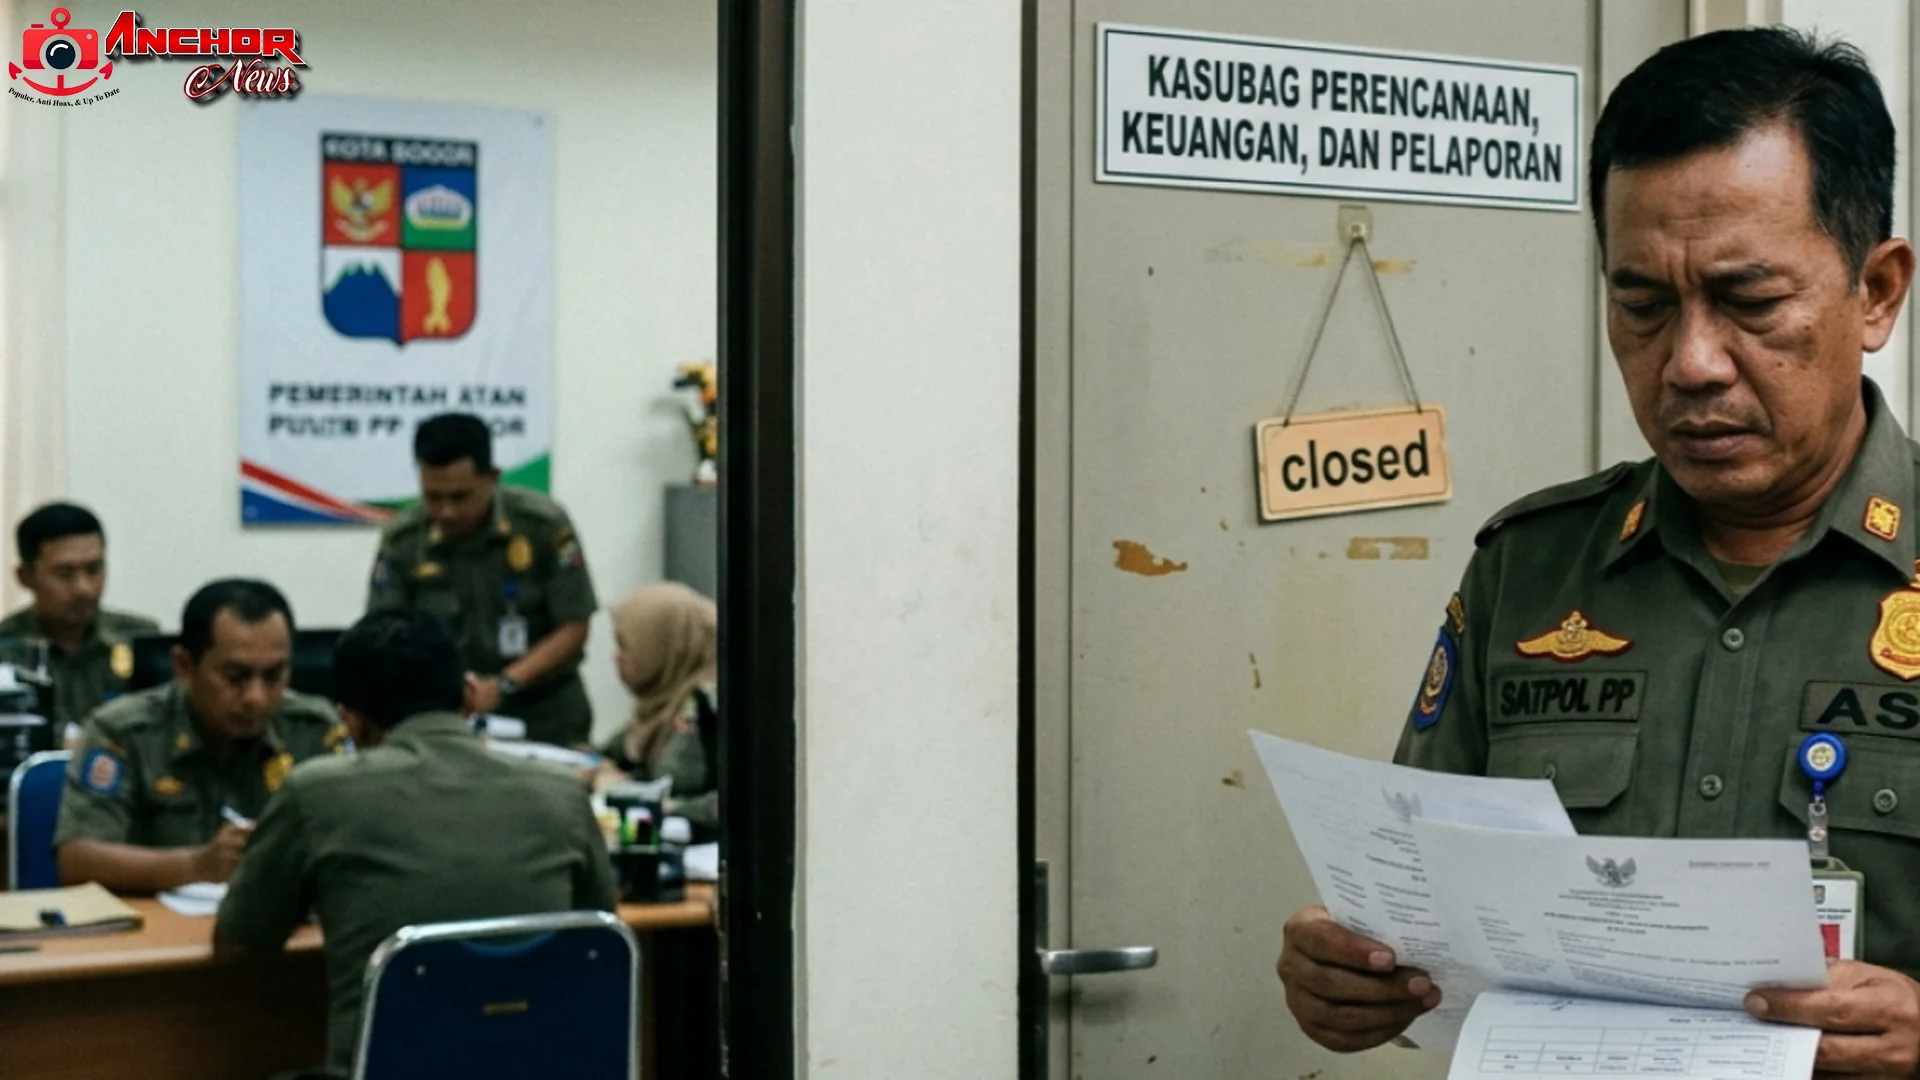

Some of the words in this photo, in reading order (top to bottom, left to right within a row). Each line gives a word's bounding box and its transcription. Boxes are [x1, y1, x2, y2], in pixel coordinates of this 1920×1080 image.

[1148, 54, 1300, 108] KASUBAG
[1311, 69, 1540, 137] PERENCANAAN,
[1122, 110, 1308, 174] KEUANGAN,
[1319, 126, 1379, 171] DAN
[1391, 131, 1563, 183] PELAPORAN
[1281, 428, 1430, 492] closed
[1501, 678, 1590, 717] SATPOL
[1597, 678, 1635, 713] PP
[1816, 686, 1920, 730] AS
